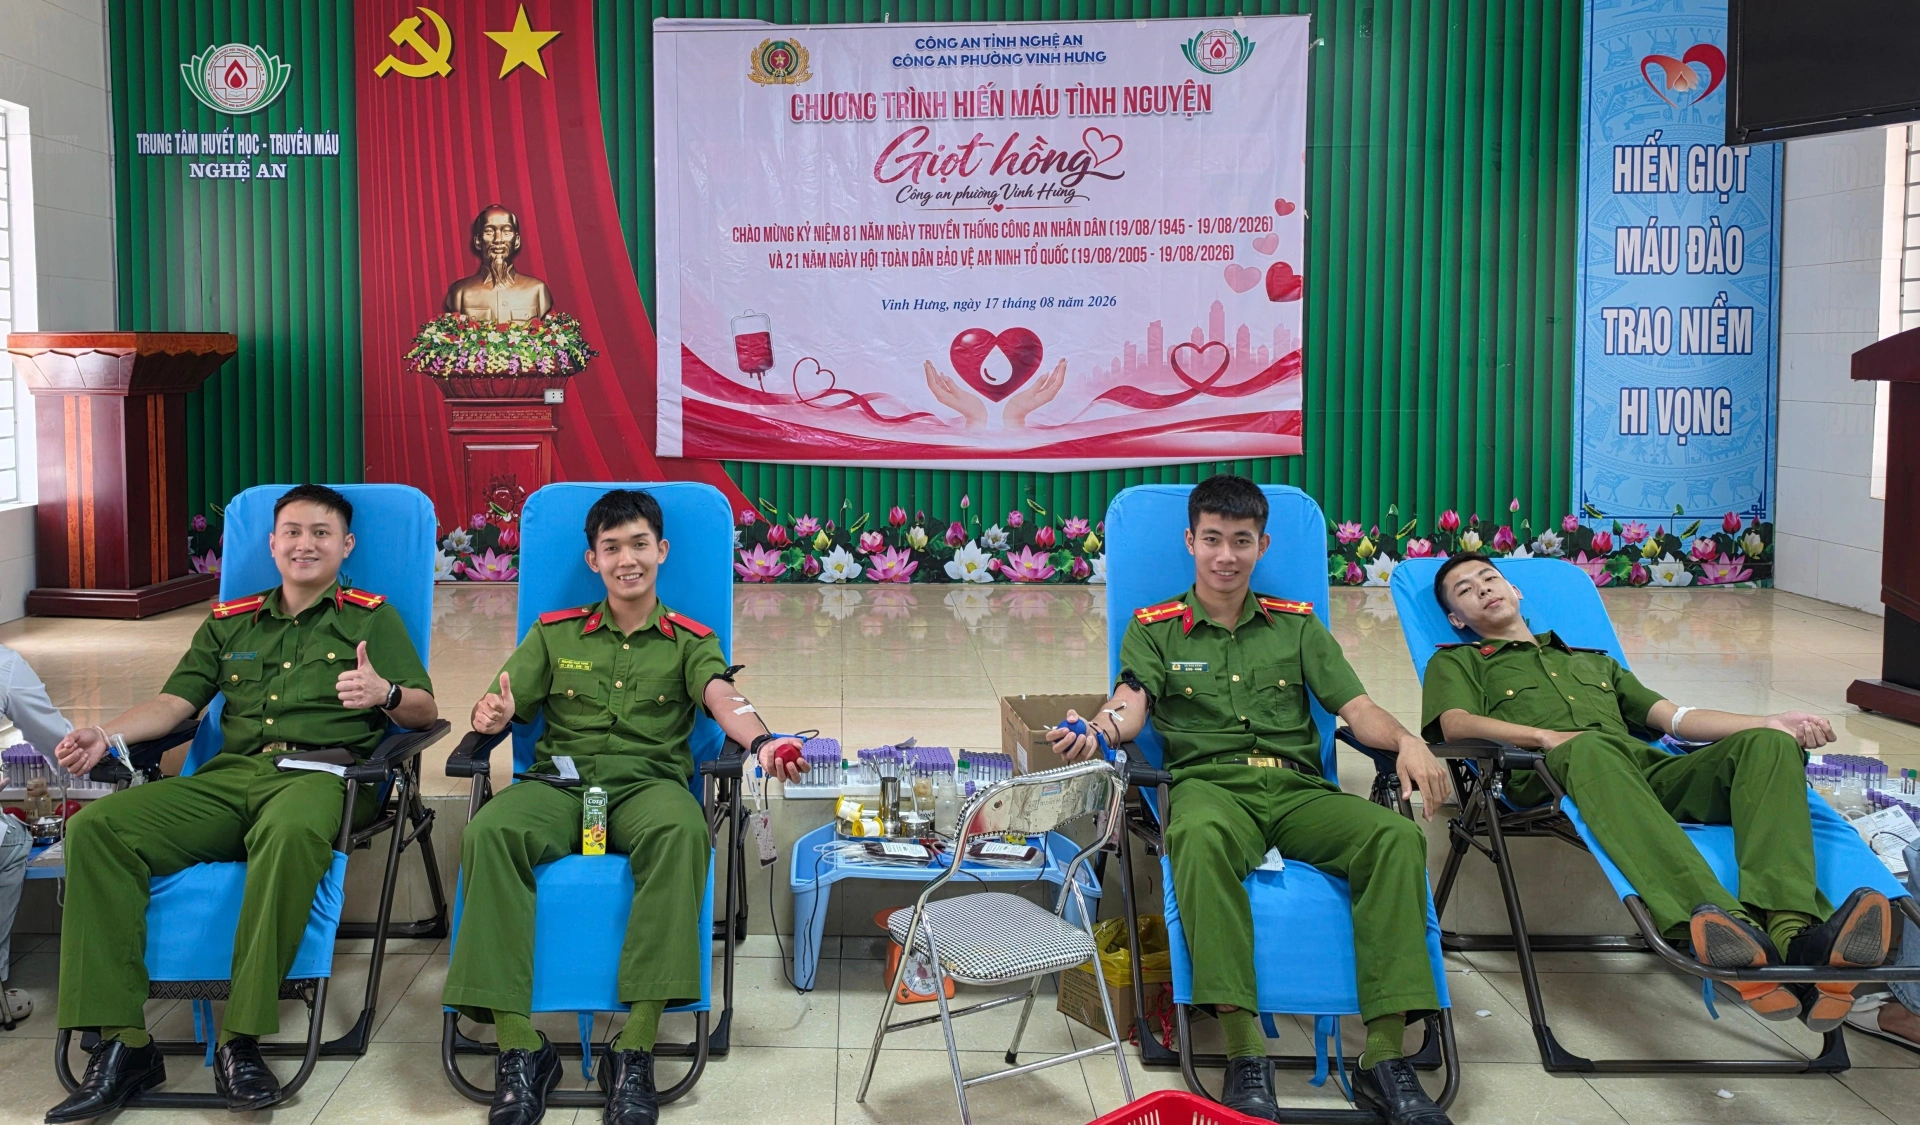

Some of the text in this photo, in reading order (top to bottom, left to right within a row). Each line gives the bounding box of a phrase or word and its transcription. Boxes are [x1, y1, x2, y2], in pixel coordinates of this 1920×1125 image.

[915, 33, 1082, 49] CÔNG AN TỈNH NGHỆ AN
[893, 51, 1106, 67] CÔNG AN PHƯỜNG VINH HƯNG
[791, 79, 1211, 121] CHƯƠNG TRÌNH HIẾN MÁU TÌNH NGUYỆN
[137, 134, 172, 154] TRUNG
[175, 130, 198, 153] TÂM
[201, 127, 234, 154] HUYẾT
[238, 134, 259, 159] HỌC
[270, 127, 311, 154] TRUYỀN
[315, 130, 338, 154] MÁU
[874, 126, 1125, 187] Giọt hồng
[189, 160, 286, 181] NGHỆ AN
[1614, 132, 1750, 202] HIẾN GIỌT
[896, 182, 1090, 206] Công an phường Vinh Hưng
[733, 224, 760, 242] CHÀO
[763, 221, 794, 242] MỪNG
[797, 221, 811, 241] KỶ
[814, 223, 840, 244] NIỆM
[844, 225, 856, 241] 81
[861, 222, 883, 240] NĂM
[887, 221, 915, 240] NGÀY
[918, 219, 959, 239] TRUYỀN
[963, 218, 998, 239] THỐNG
[1002, 219, 1029, 238] CÔNG
[1033, 222, 1047, 237] AN
[1051, 218, 1080, 237] NHÂN
[1084, 217, 1106, 236] DÂN
[1110, 219, 1185, 236] (19/08/1945
[1198, 216, 1272, 234] 19/08/2026)
[1616, 217, 1743, 273] MÁU ĐÀO
[769, 250, 783, 268] VÀ
[786, 253, 798, 268] 21
[803, 250, 826, 268] NĂM
[830, 249, 857, 268] NGÀY
[861, 249, 877, 270] HỘI
[881, 248, 908, 267] TOÀN
[912, 248, 933, 266] DÂN
[937, 246, 957, 266] BẢO
[961, 247, 974, 269] VỆ
[977, 250, 991, 265] AN
[995, 249, 1020, 265] NINH
[1024, 242, 1038, 264] TỔ
[1041, 244, 1068, 265] QUỐC
[1072, 247, 1147, 263] (19/08/2005
[1160, 245, 1233, 262] 19/08/2026)
[882, 296, 1116, 312] Vinh Hưng, ngày 17 tháng 08 năm 2026
[1603, 293, 1752, 354] TRAO NIỀM
[1620, 388, 1731, 444] HI VỌNG
